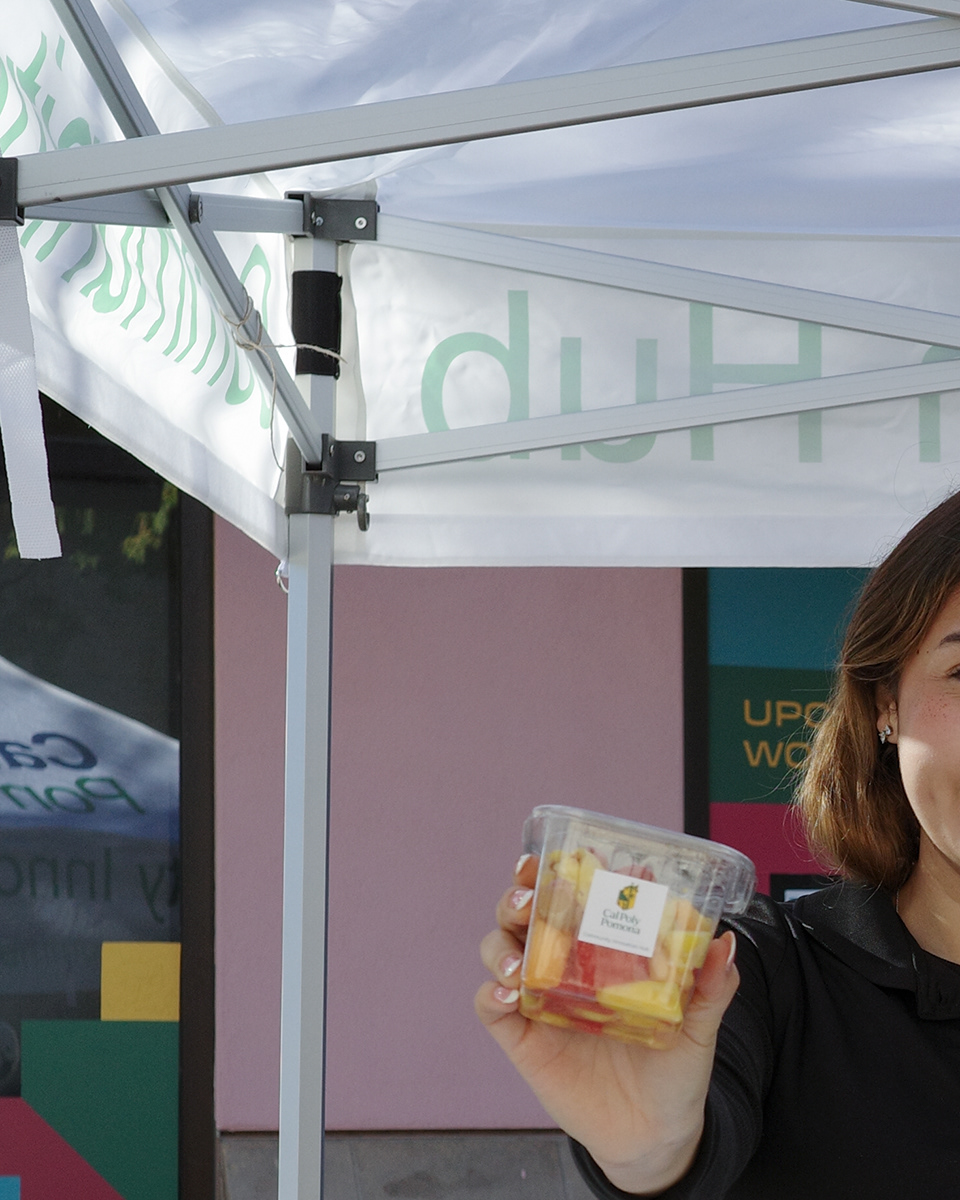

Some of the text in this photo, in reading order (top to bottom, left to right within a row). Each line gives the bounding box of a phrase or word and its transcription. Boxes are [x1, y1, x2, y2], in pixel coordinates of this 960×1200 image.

[602, 909, 640, 925] Cal Poly
[600, 918, 640, 934] Pomona
